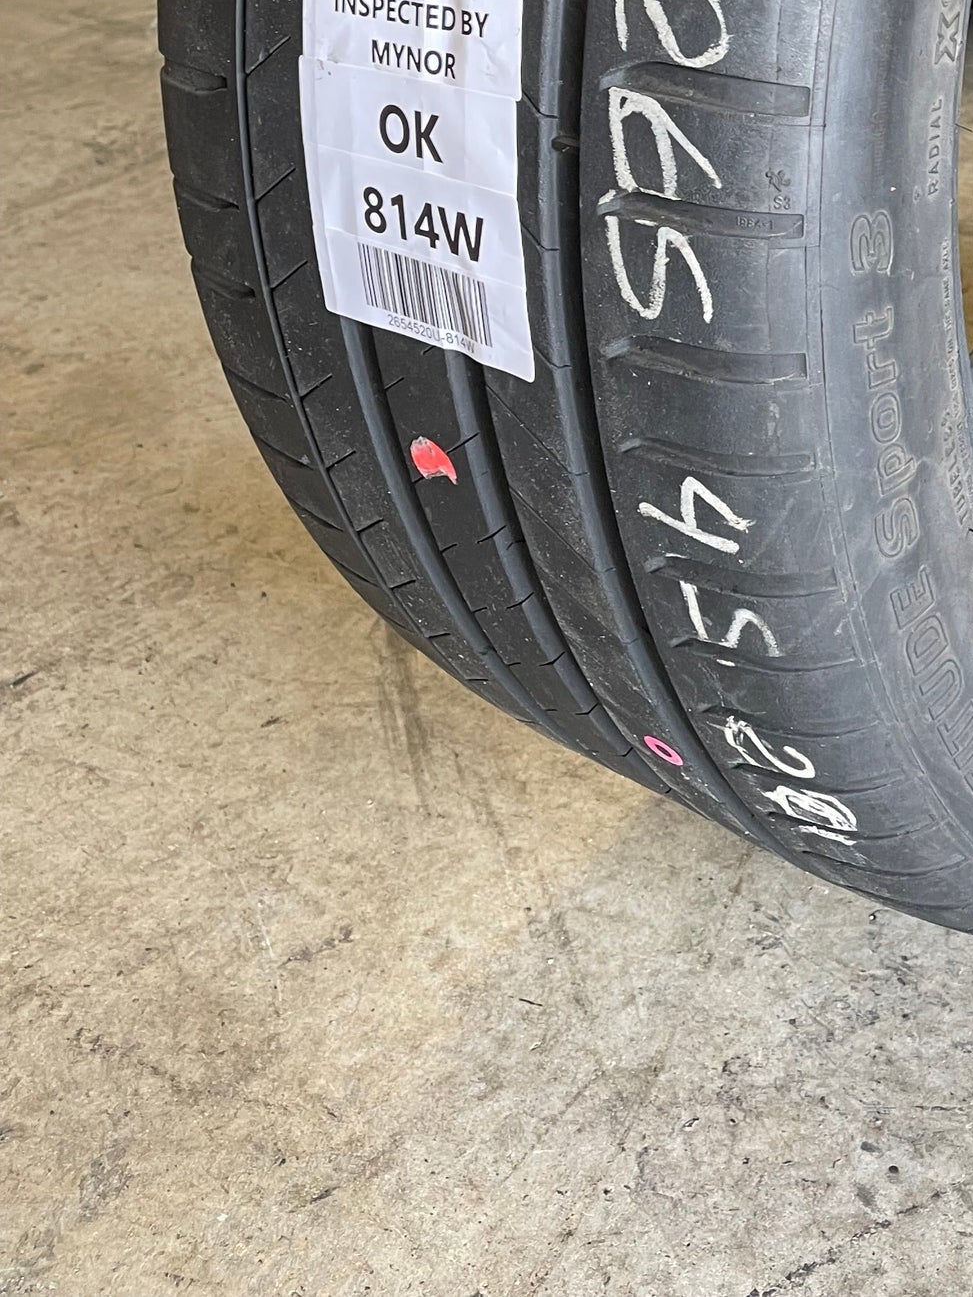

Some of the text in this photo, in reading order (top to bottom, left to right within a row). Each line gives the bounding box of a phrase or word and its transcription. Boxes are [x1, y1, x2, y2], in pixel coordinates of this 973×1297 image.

[461, 9, 489, 38] BY
[372, 39, 456, 79] MYNOR
[379, 104, 444, 163] OK
[927, 96, 944, 197] RADIAL
[362, 186, 484, 263] 814W
[849, 209, 893, 274] 3
[387, 314, 476, 354] 2654520U-814W
[852, 306, 920, 560] Sport
